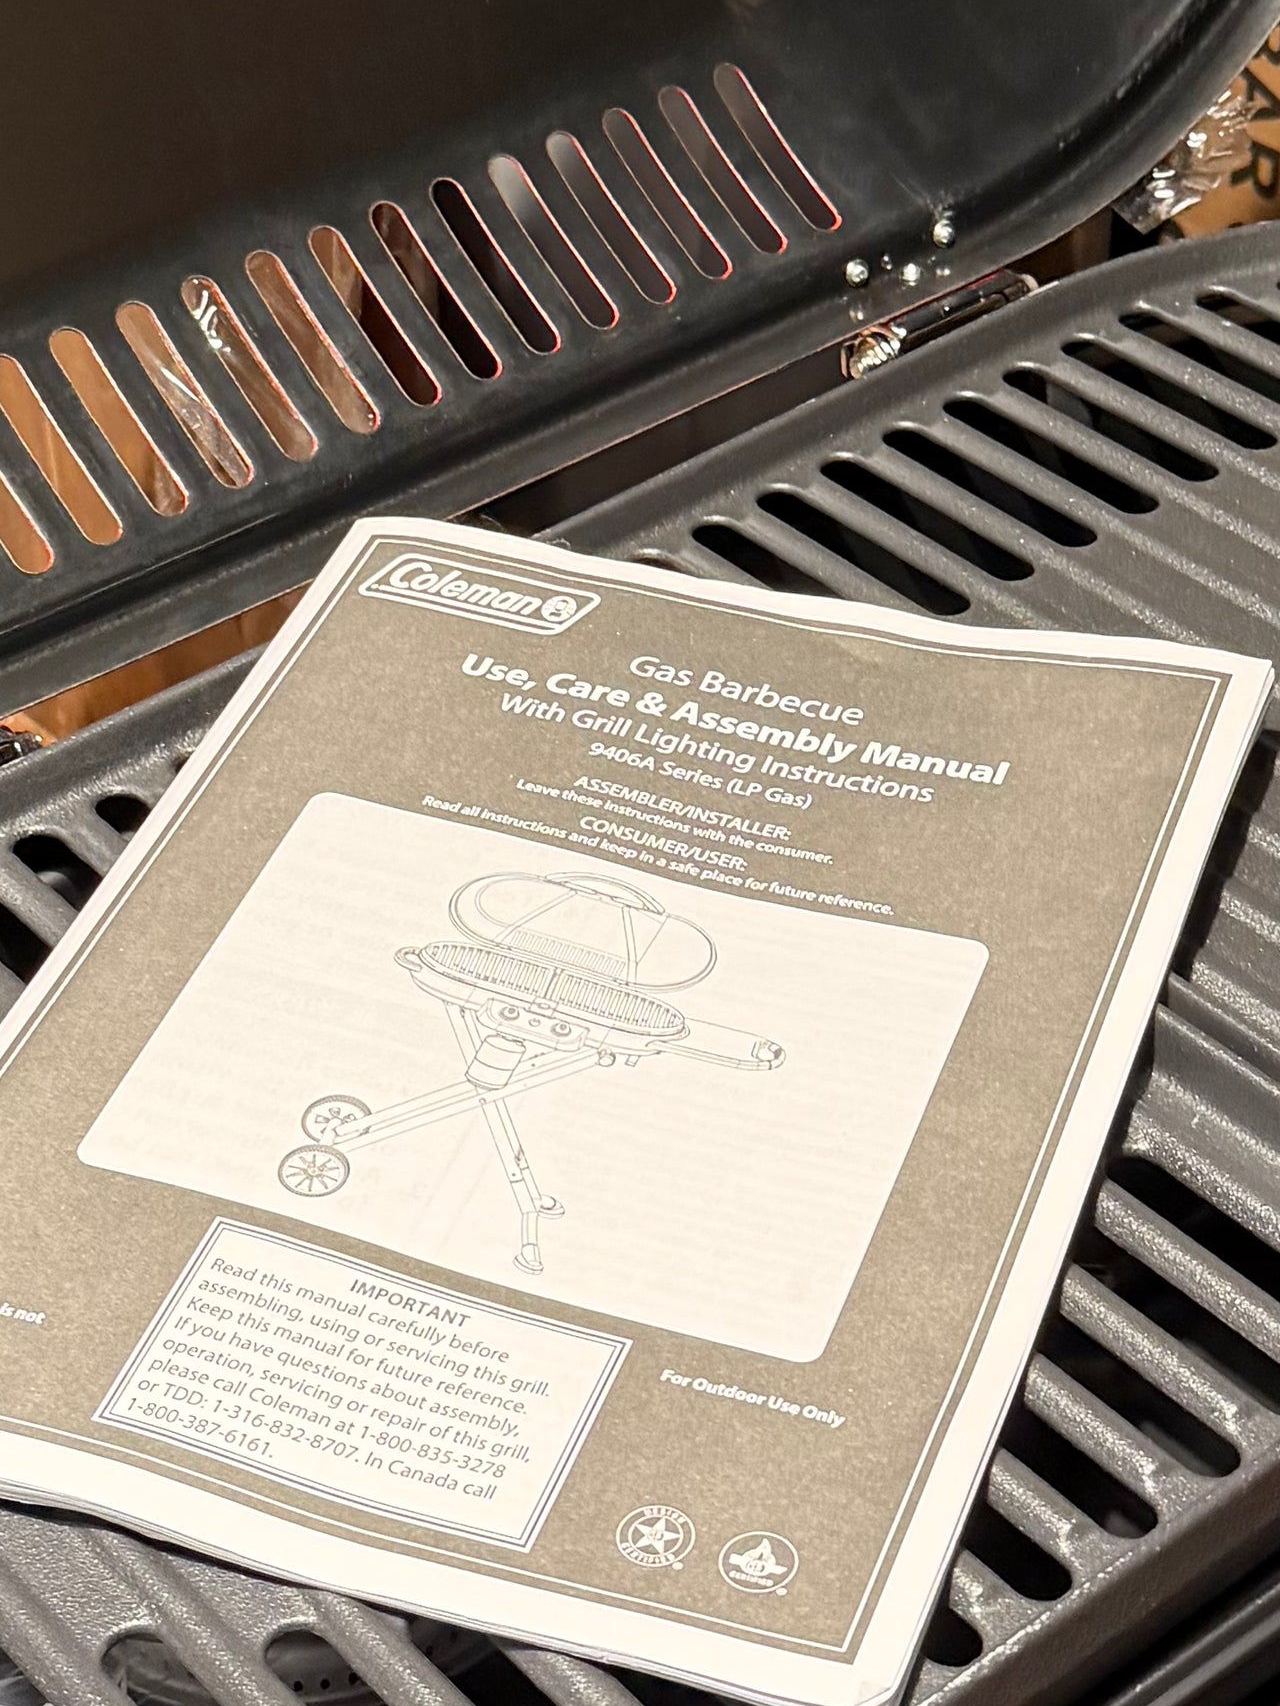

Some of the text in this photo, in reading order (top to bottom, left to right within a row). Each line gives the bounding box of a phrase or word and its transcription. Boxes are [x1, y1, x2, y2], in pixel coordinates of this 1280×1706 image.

[389, 561, 543, 616] Coleman
[461, 653, 1012, 787] Use, Care & Assembly Manual
[629, 654, 865, 727] Gas Barbecue
[501, 693, 935, 805] With Grill Lighting Instructions
[588, 742, 813, 812] 9406A Series (LP Gas)
[422, 794, 895, 917] Read all instructions and keep in a safe place for future reference.
[515, 778, 834, 865] Leave these instructions with the consumer.
[573, 775, 792, 842] ASSEMBLER/INSTALLER:
[579, 815, 748, 872] CONSUMER/USER:
[13, 1309, 47, 1325] not
[198, 1278, 551, 1398] assembling, using or servicing this grill.
[210, 1258, 511, 1364] Read this manual carefully before
[350, 1279, 472, 1328] IMPORTANT
[162, 1338, 531, 1464] operation, servicing or repair of this grill,
[174, 1315, 520, 1438] If you have questions about assembly,
[186, 1295, 528, 1415] Keep this manual for future reference.
[659, 1368, 847, 1429] For Outdoor Use Only
[126, 1396, 274, 1459] 1-800-387-6161.
[137, 1379, 498, 1501] or TDD: 1-316-832-8707. In Canada call
[147, 1357, 507, 1480] please call Coleman at 1-800-835-3278
